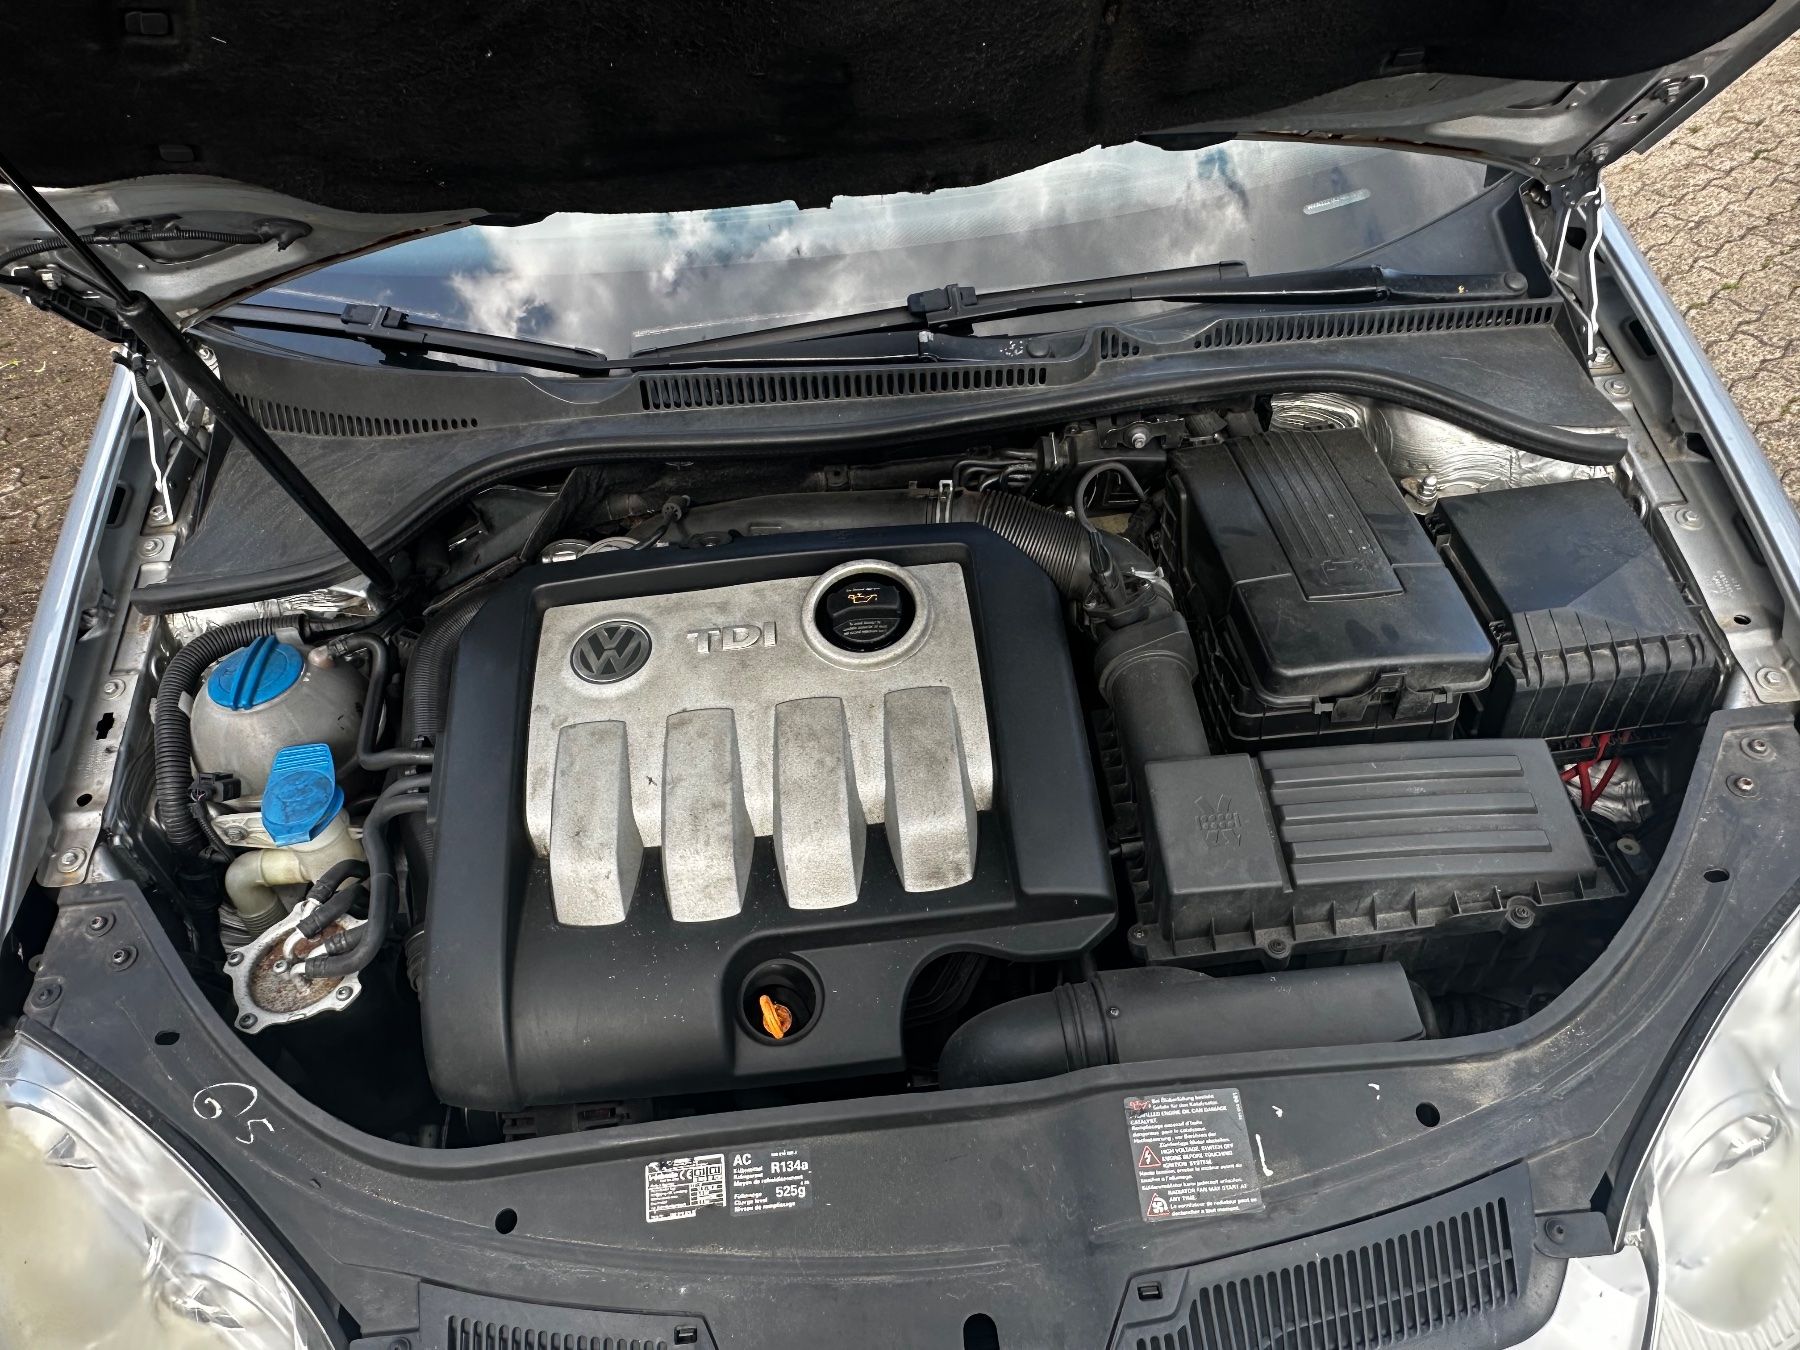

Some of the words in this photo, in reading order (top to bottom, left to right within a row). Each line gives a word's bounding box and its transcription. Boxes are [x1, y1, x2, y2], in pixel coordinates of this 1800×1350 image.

[686, 621, 777, 653] TDI
[733, 1154, 751, 1167] AC
[771, 1159, 808, 1174] R134a
[776, 1184, 805, 1201] 525g
